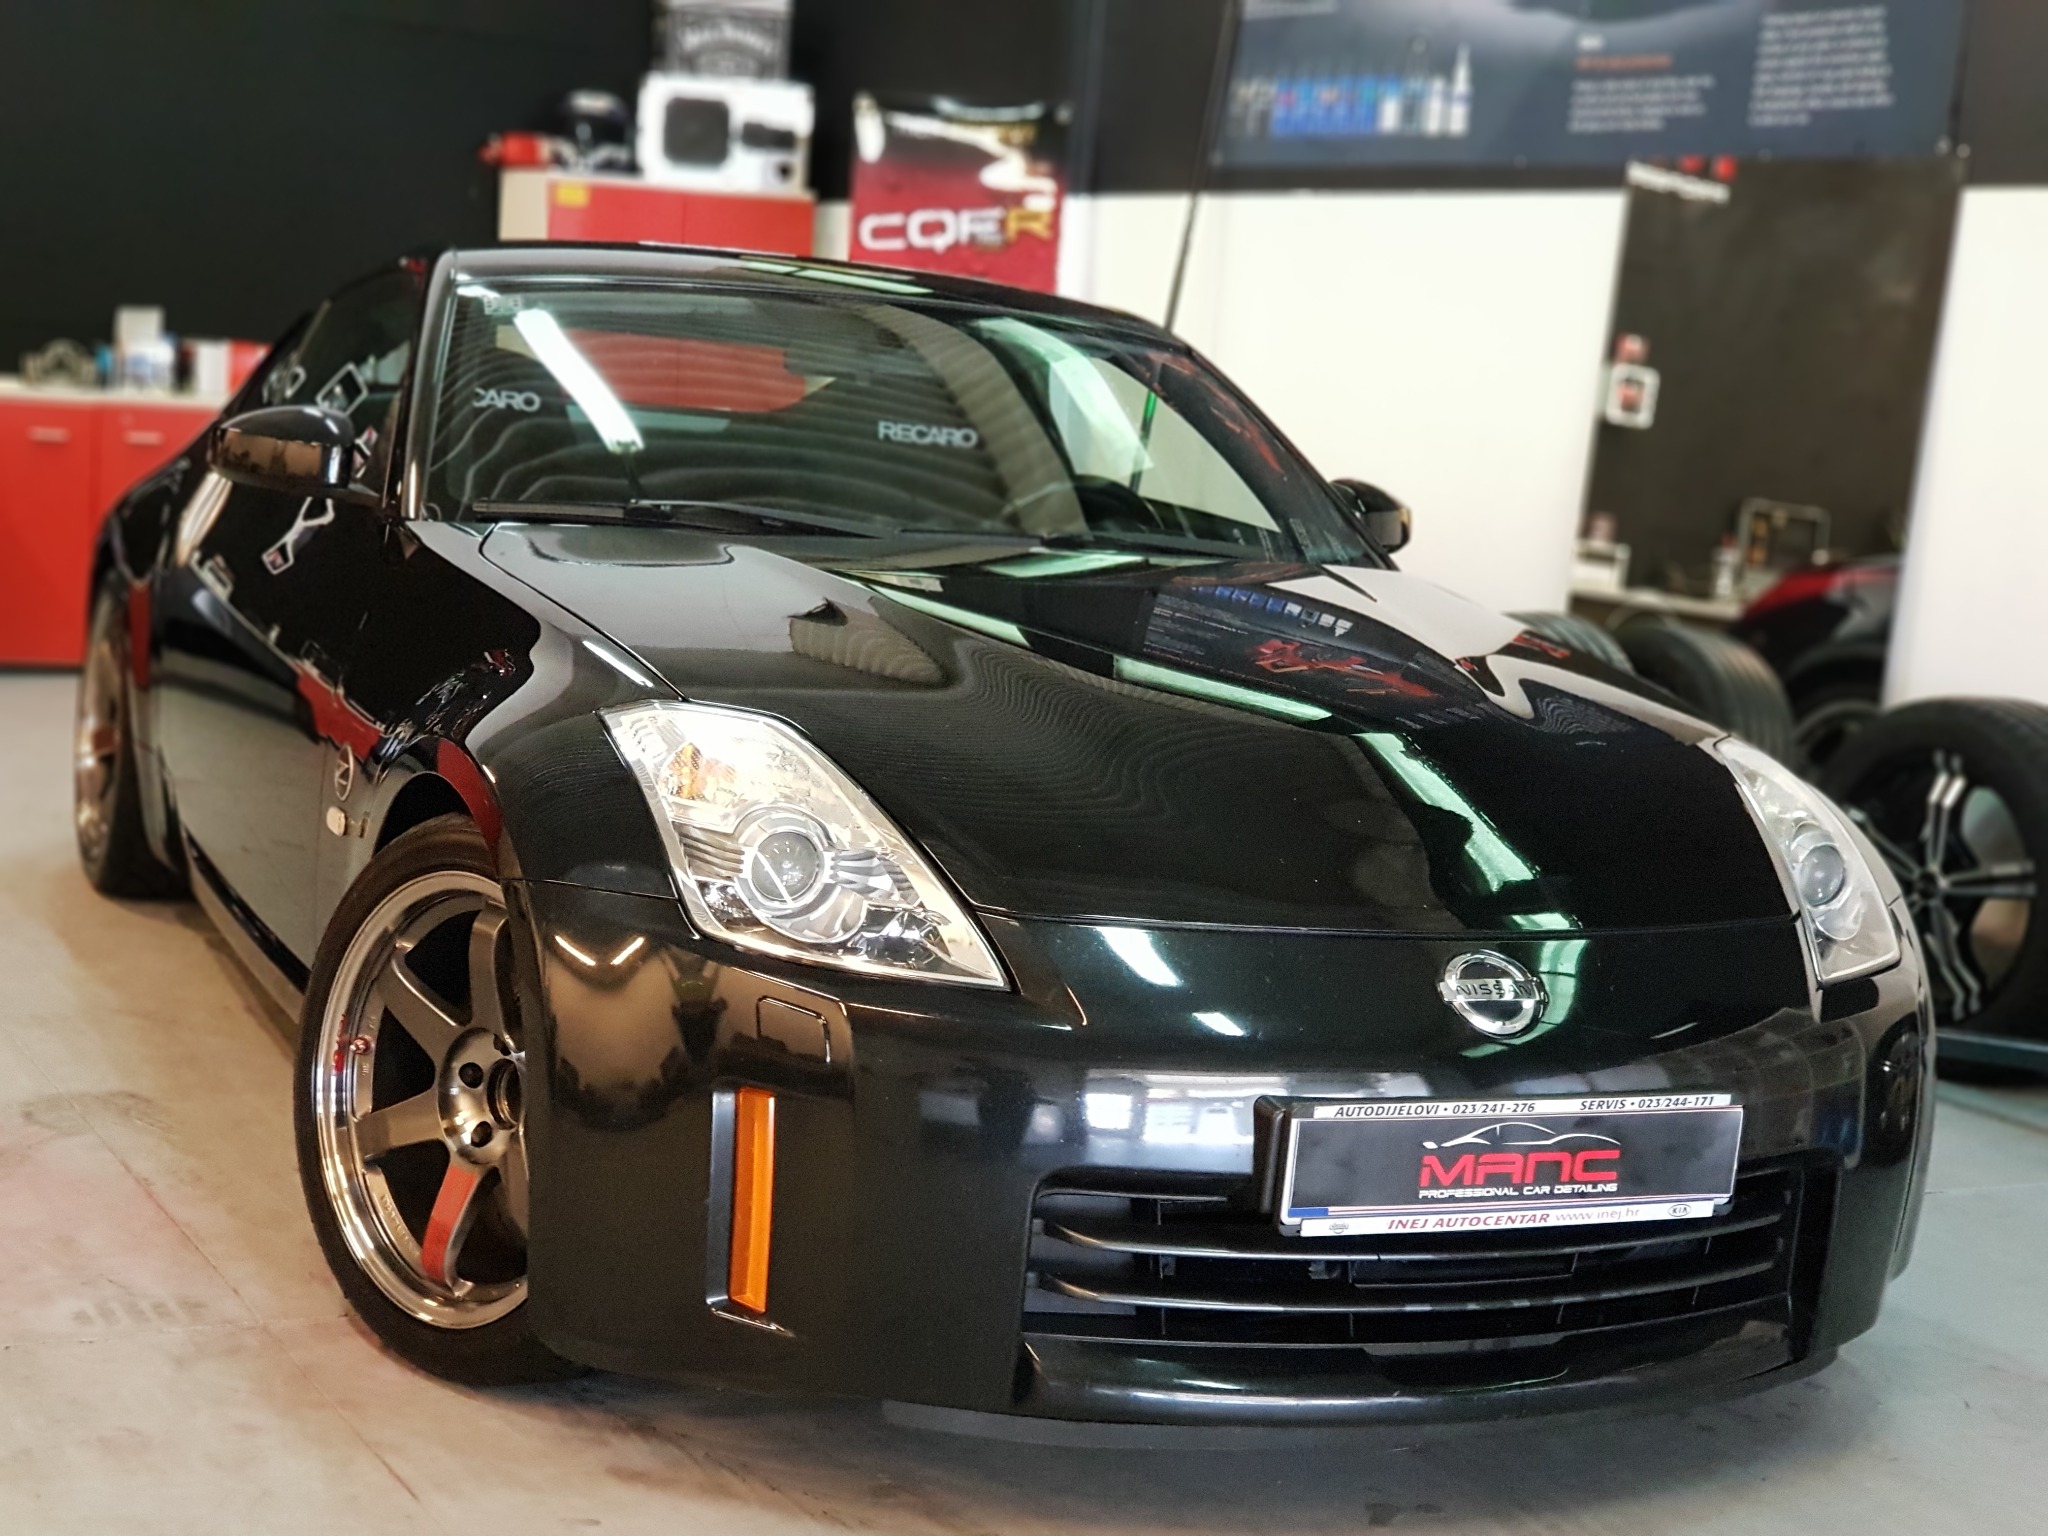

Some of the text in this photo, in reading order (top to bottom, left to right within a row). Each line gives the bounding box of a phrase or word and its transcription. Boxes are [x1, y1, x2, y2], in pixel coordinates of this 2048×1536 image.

[878, 421, 978, 449] RECARO
[1334, 1102, 1536, 1118] AUTODIJELOVI 023/241-276
[1580, 1095, 1715, 1111] SERVIS 023/244-171
[1418, 1182, 1618, 1200] PROFESSIONAL CAR DETAILING
[1388, 1218, 1429, 1231] INEJ
[1433, 1213, 1550, 1229] AUTOCENTAR
